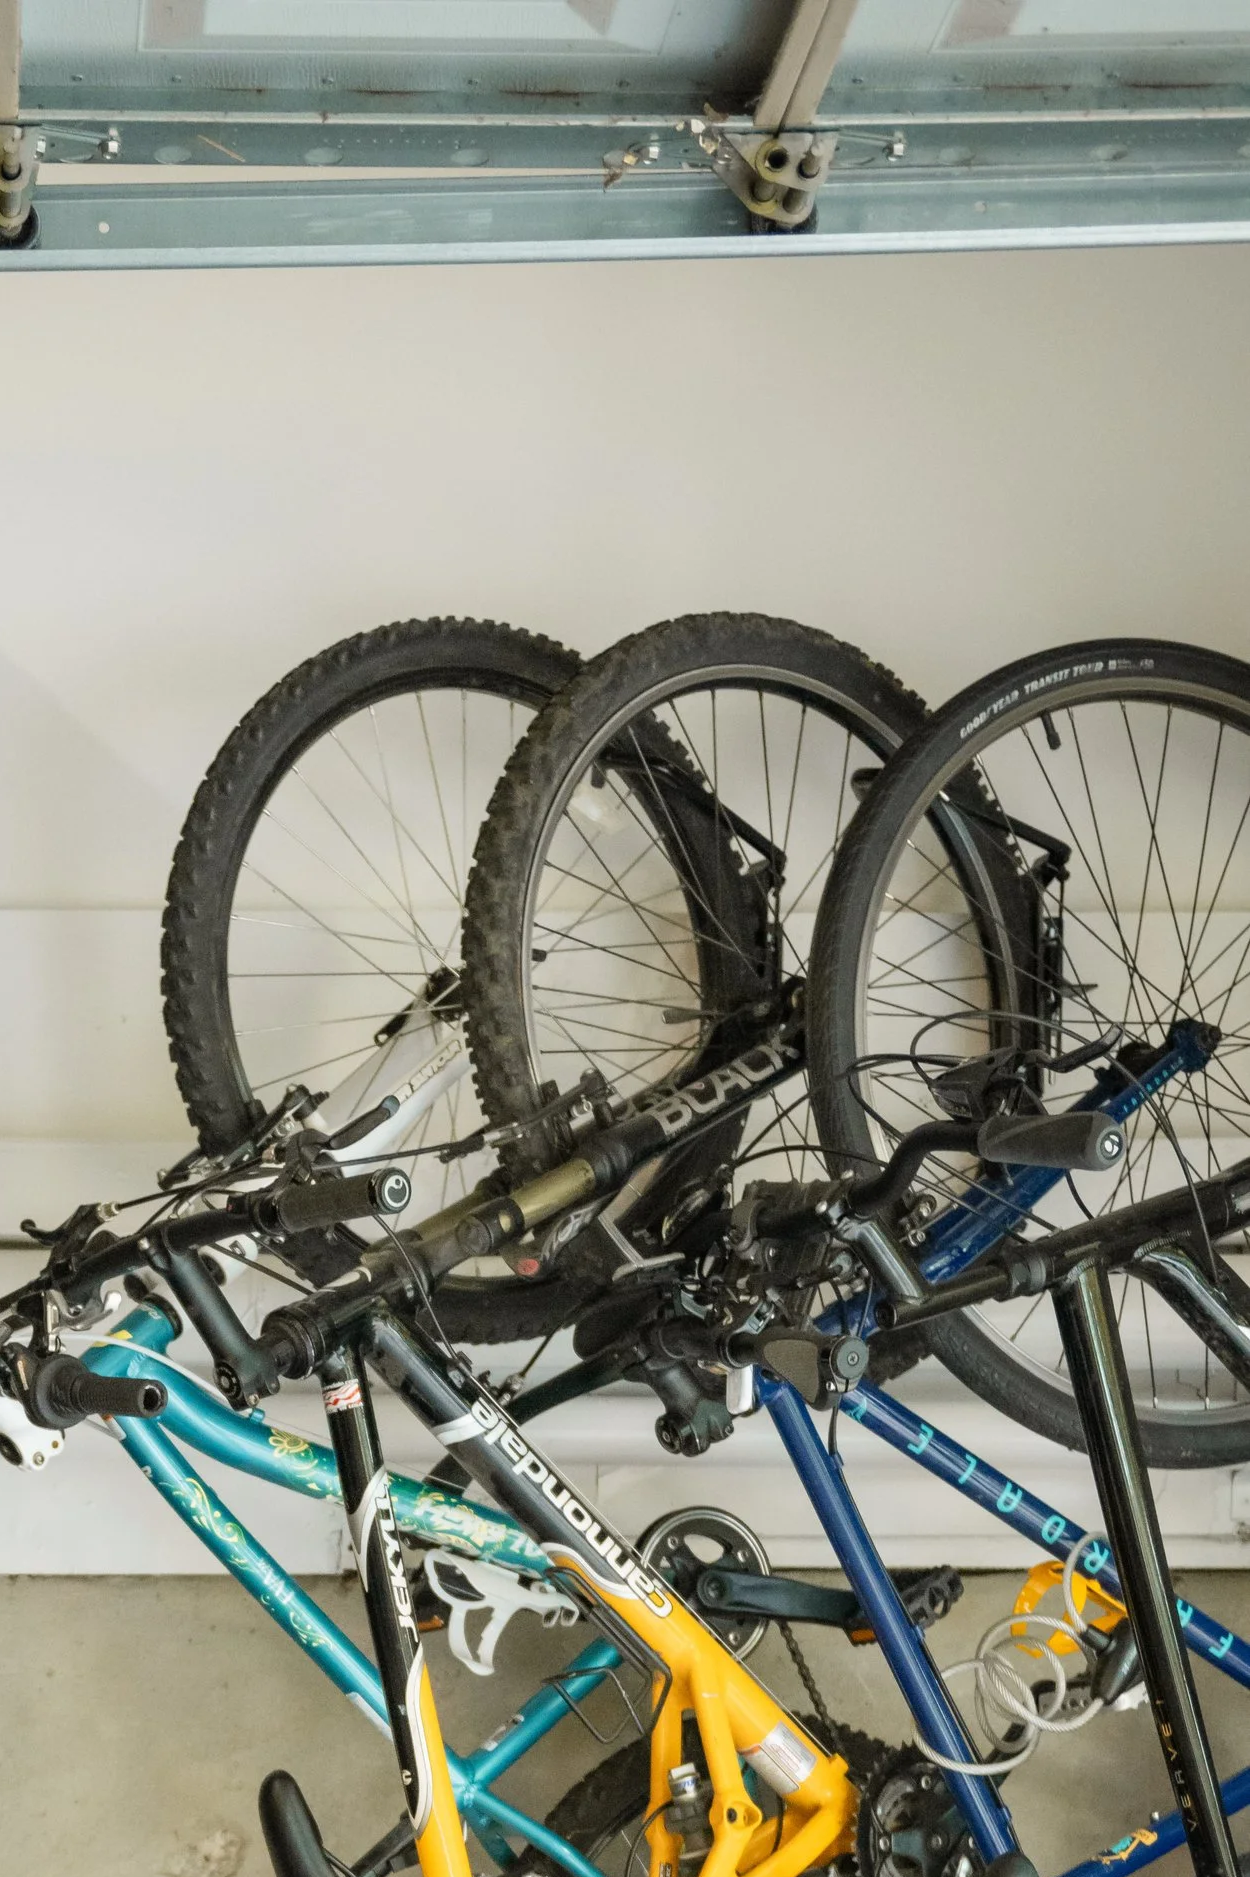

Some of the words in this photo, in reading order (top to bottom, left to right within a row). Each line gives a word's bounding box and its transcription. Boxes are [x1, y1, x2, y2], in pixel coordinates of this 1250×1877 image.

[1023, 668, 1071, 696] TRANSIT
[375, 1484, 420, 1643] JEKYLL
[470, 1397, 674, 1619] cannondale
[907, 1422, 1235, 1660] FARDALE
[1161, 1721, 1198, 1832] VERVE
